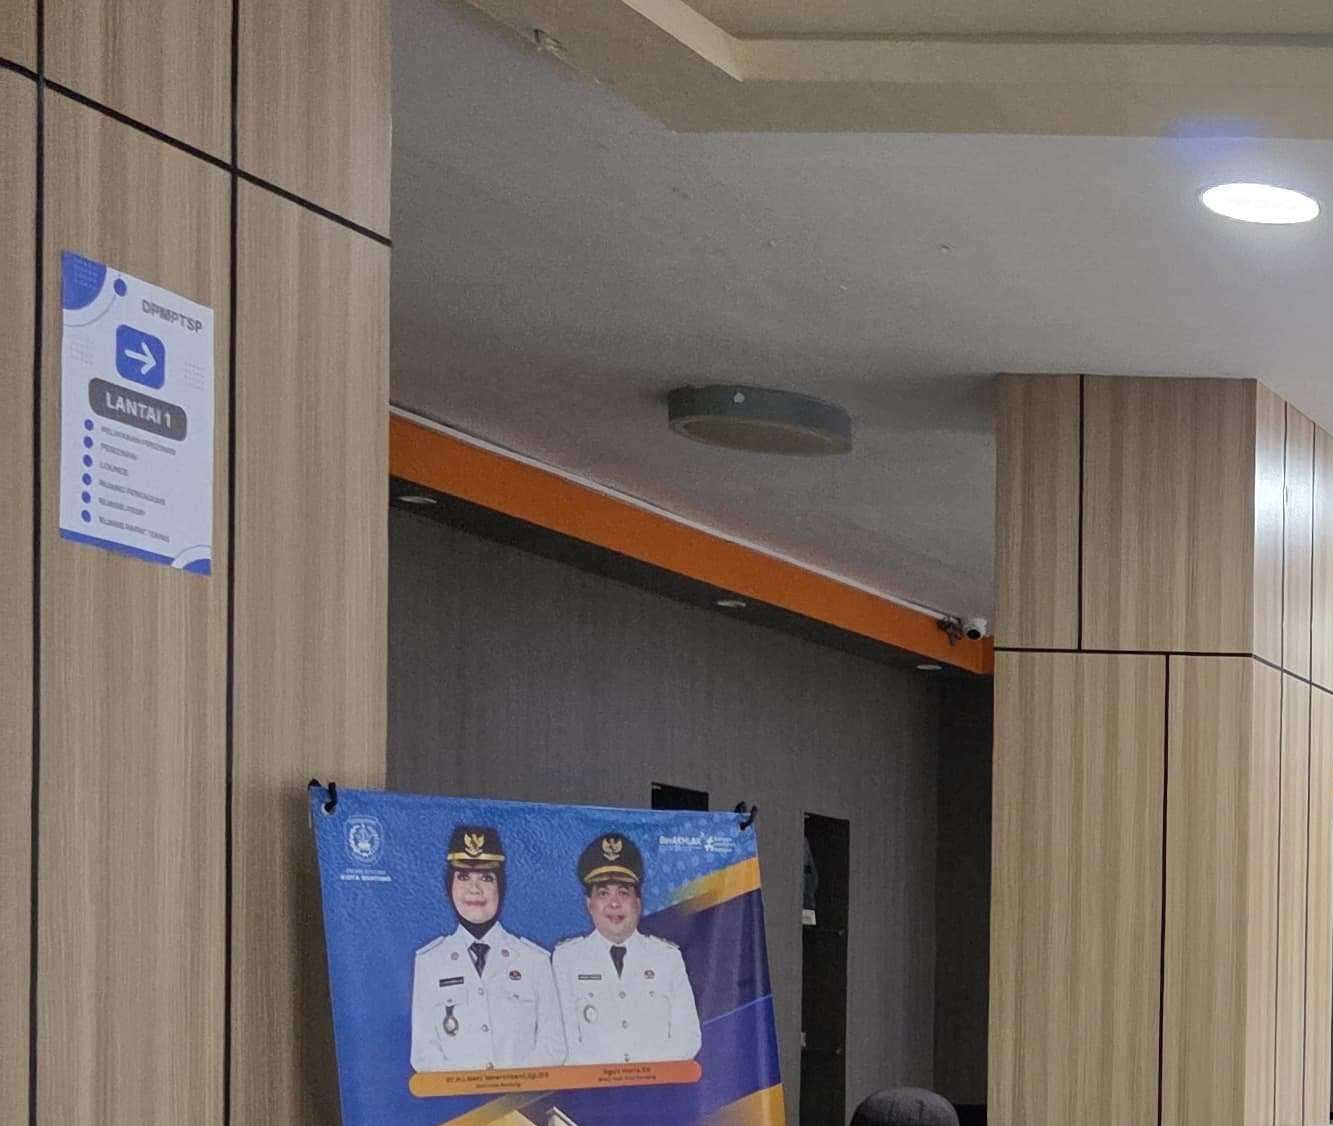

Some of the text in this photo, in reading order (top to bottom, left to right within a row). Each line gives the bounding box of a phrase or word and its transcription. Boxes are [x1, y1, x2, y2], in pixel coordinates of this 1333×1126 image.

[142, 299, 203, 333] DPMPTSP
[105, 391, 171, 429] LANTAI 1
